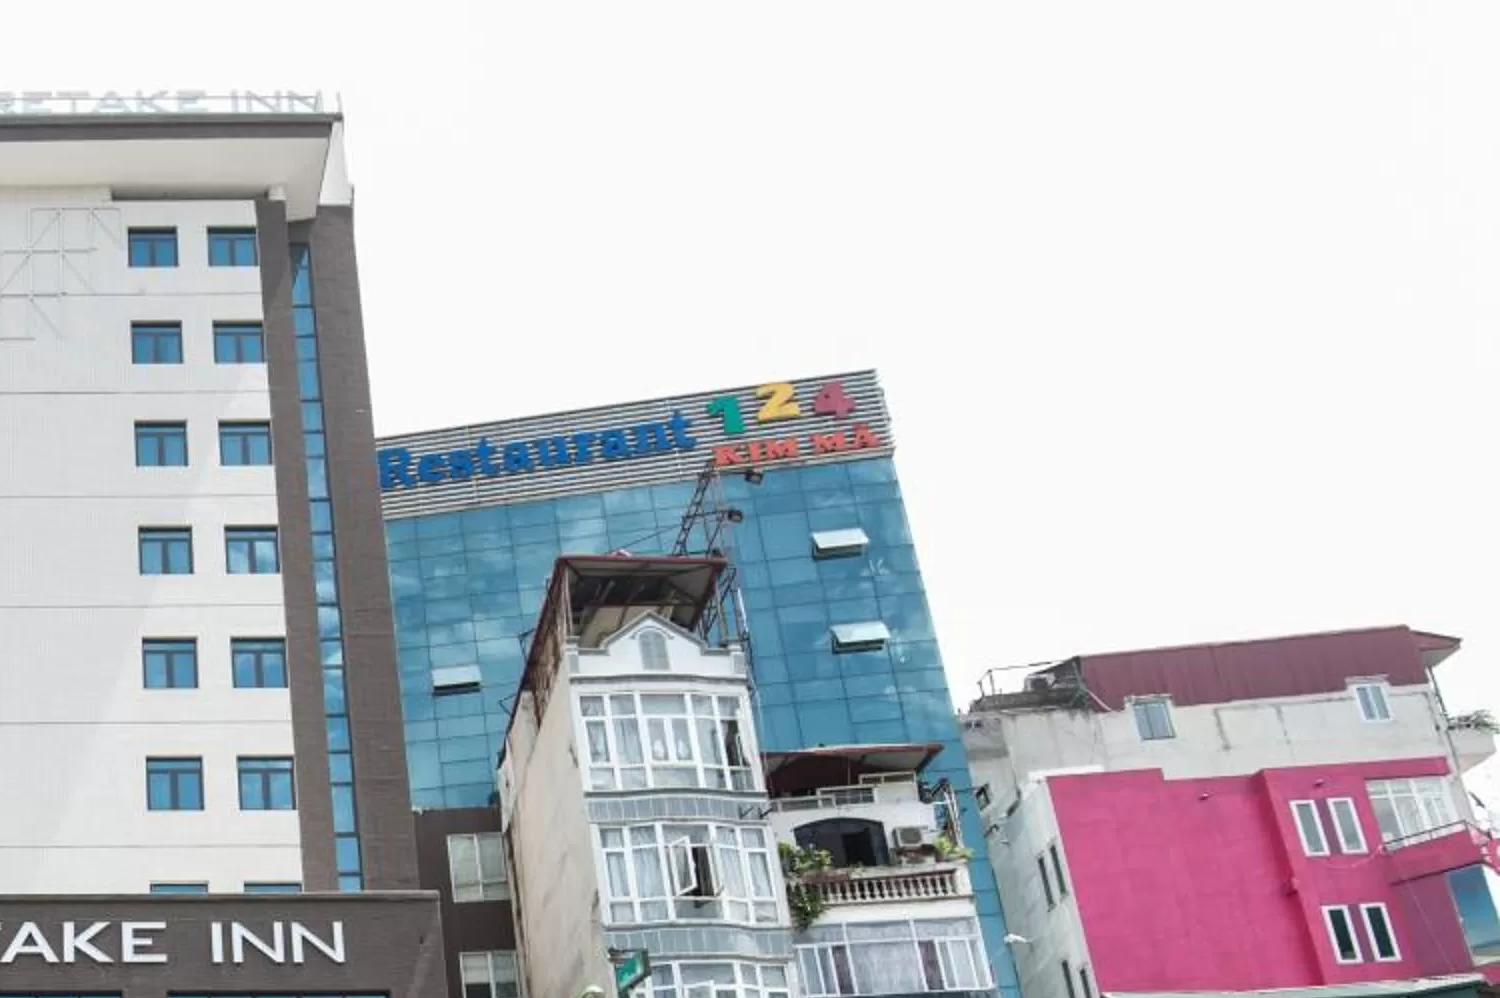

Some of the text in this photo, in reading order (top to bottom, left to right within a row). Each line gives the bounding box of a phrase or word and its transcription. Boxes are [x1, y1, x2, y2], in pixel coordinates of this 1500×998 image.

[231, 90, 322, 112] INN
[707, 381, 855, 433] 124
[377, 410, 697, 489] Restaurant
[712, 437, 798, 465] KIM
[211, 921, 346, 963] INN
